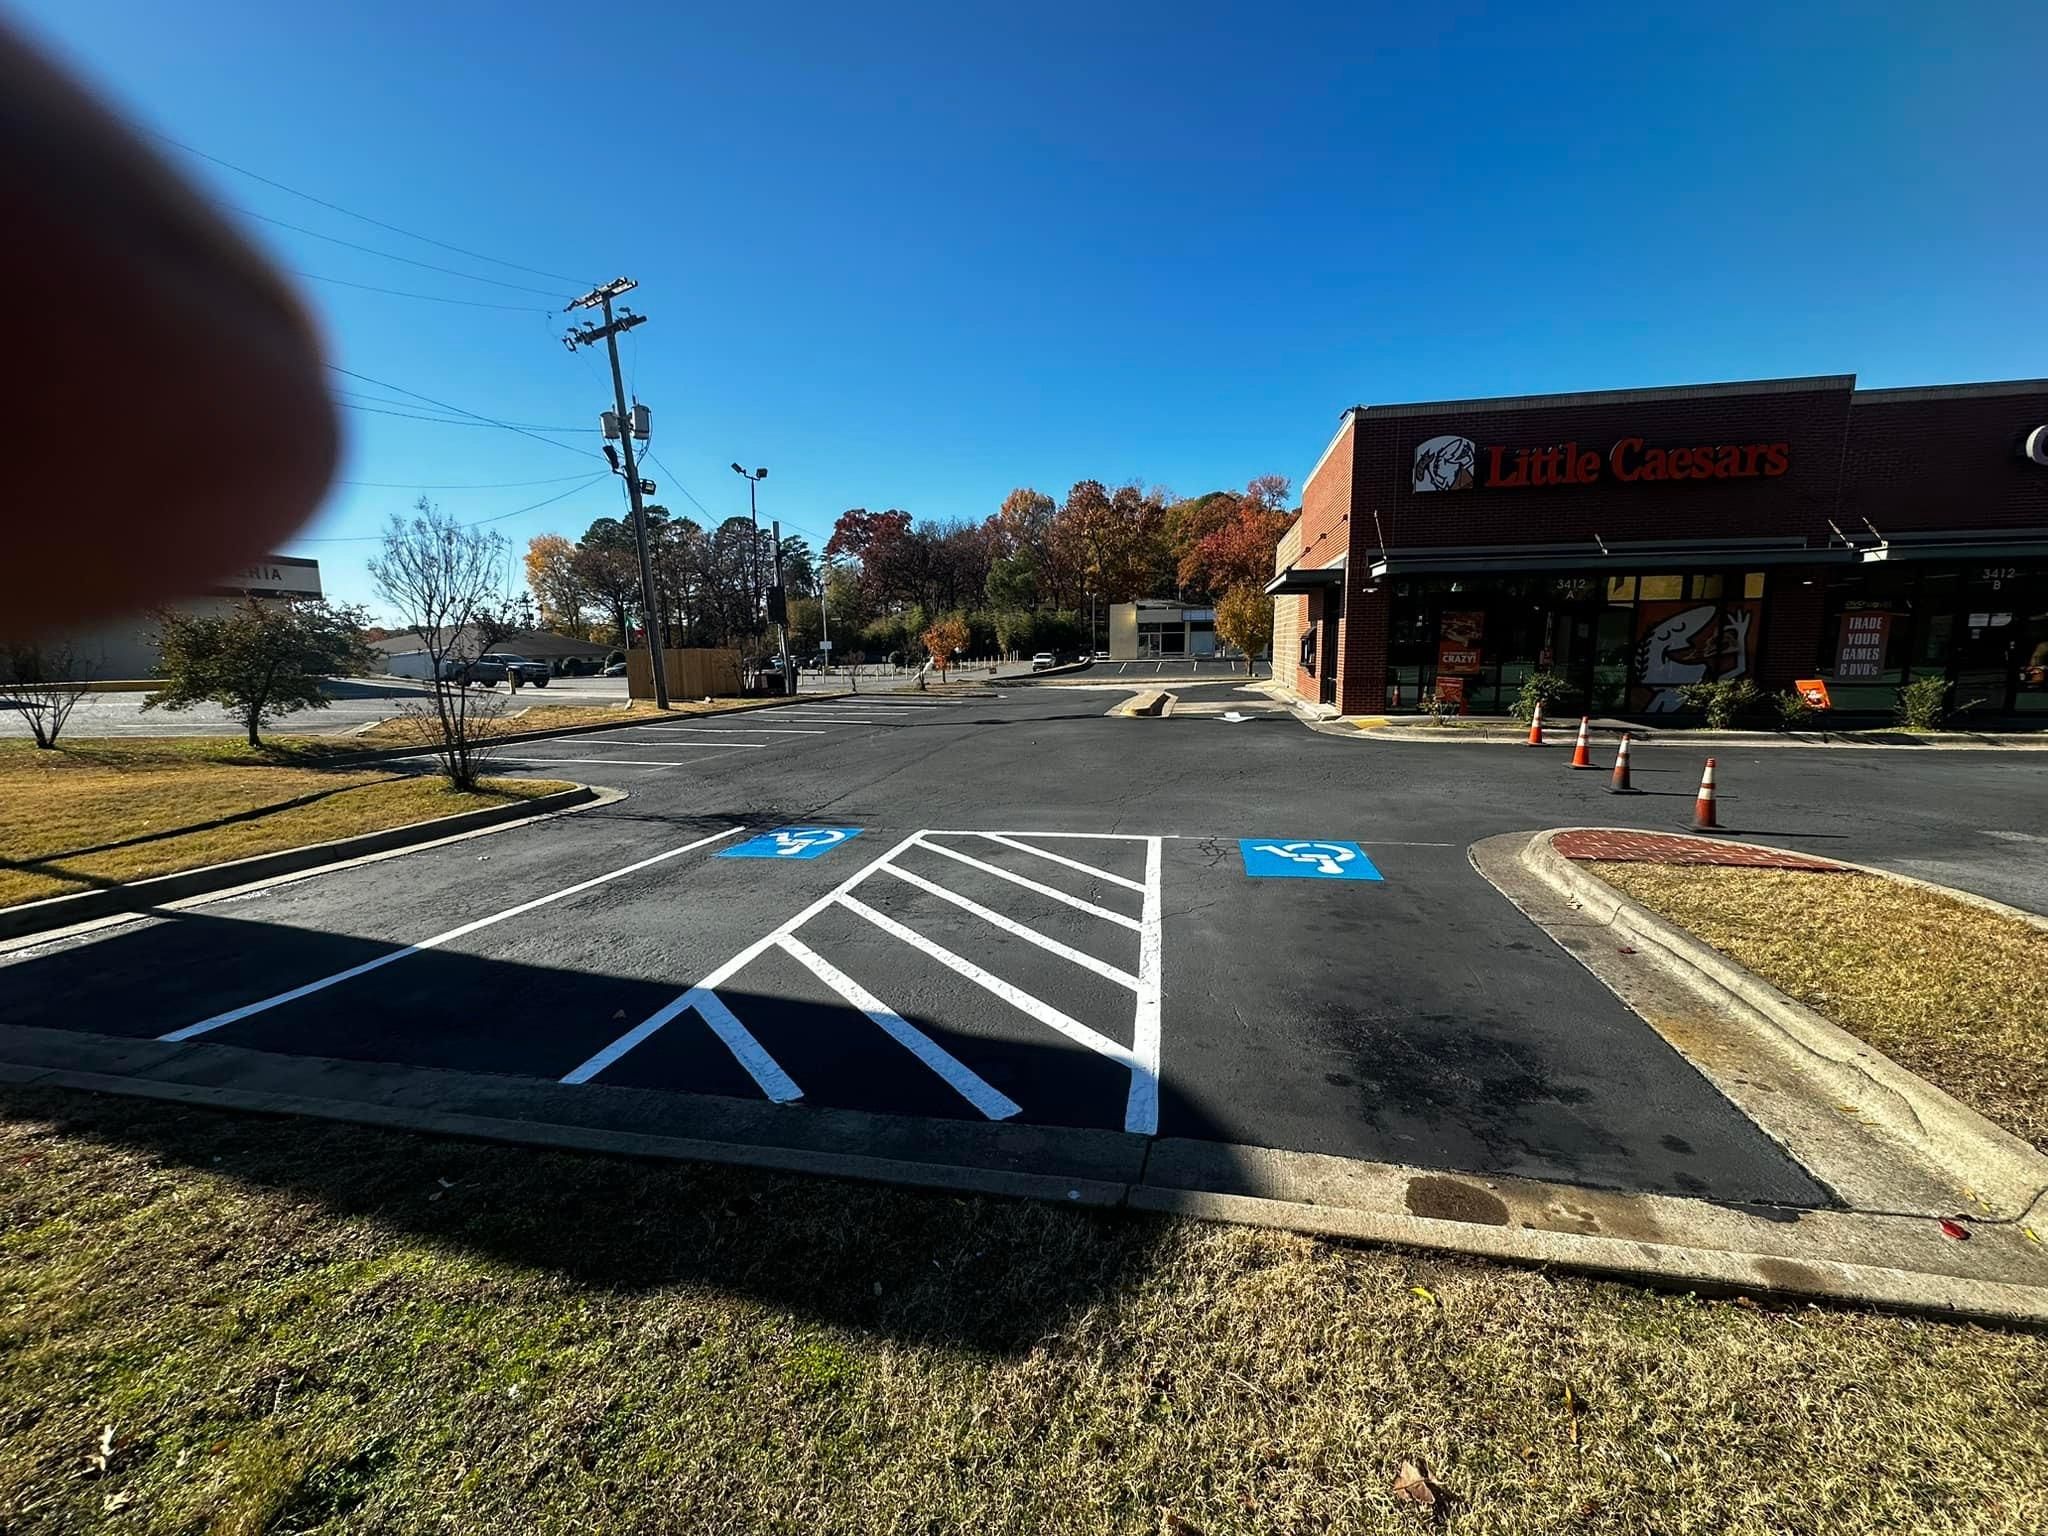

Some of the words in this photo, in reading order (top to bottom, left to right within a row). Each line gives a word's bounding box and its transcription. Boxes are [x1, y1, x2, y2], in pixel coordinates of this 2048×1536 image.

[1484, 440, 1601, 489] Little
[1609, 436, 1791, 482] Caesars
[1982, 567, 2016, 580] 3412
[1556, 578, 1586, 590] 3412
[1992, 580, 2001, 591] B
[1566, 590, 1575, 600] A
[1848, 616, 1883, 630] TRADE
[1847, 633, 1880, 645] YOUR
[1442, 655, 1477, 664] CRAZY!
[1842, 648, 1880, 660] GAMES
